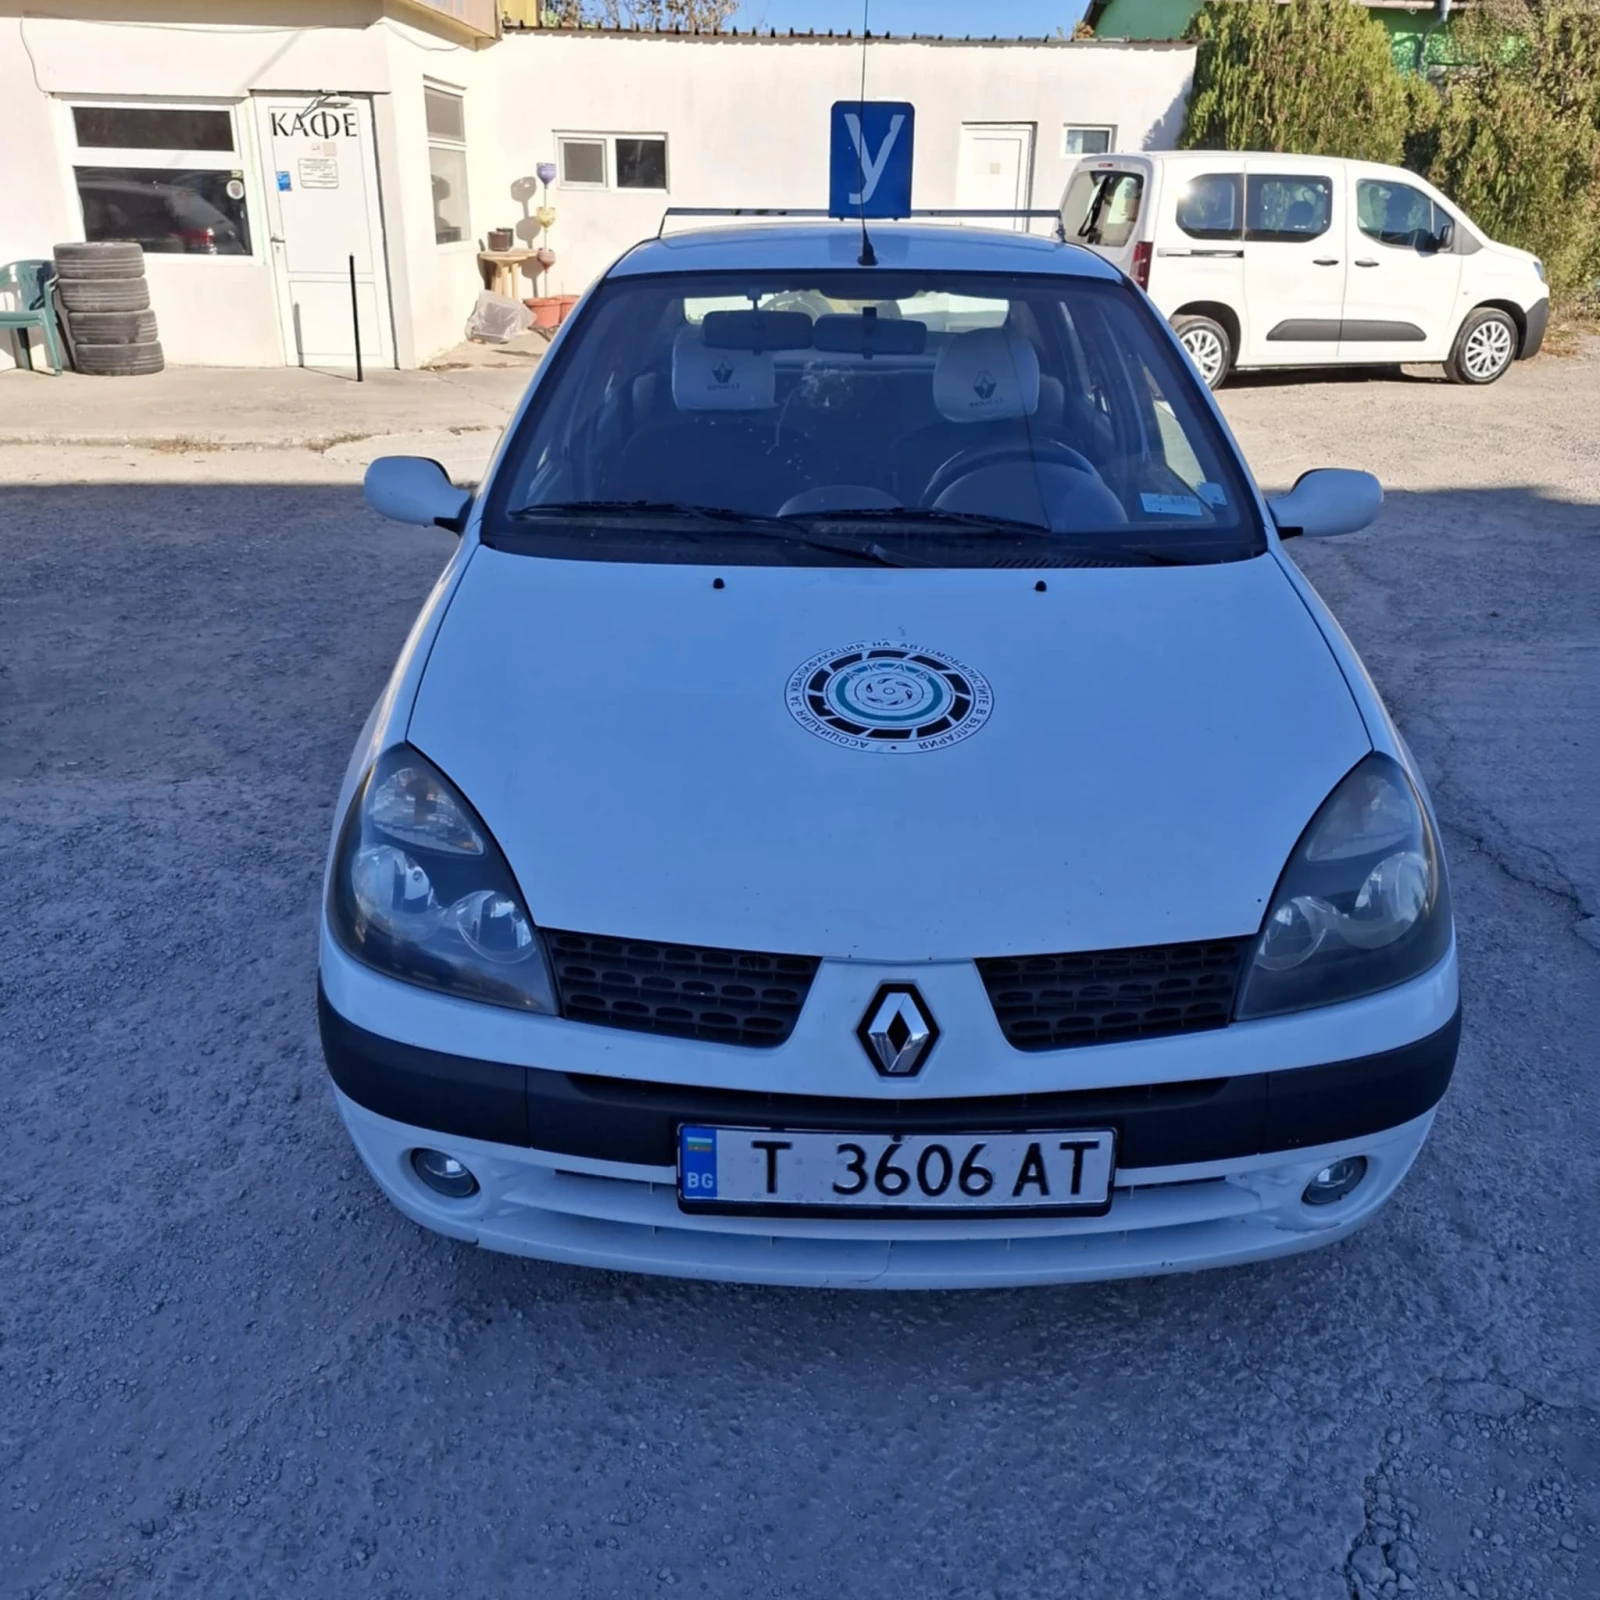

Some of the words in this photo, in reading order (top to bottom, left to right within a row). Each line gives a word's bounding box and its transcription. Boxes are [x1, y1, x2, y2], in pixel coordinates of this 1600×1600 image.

[271, 111, 358, 139] КАФЕ
[790, 695, 803, 709] ЗА
[796, 709, 869, 749] АСОЦИАЦИЯ
[917, 718, 981, 750] БЪЛГАРИЯ
[687, 1173, 713, 1188] BG
[832, 1142, 993, 1196] 3606
